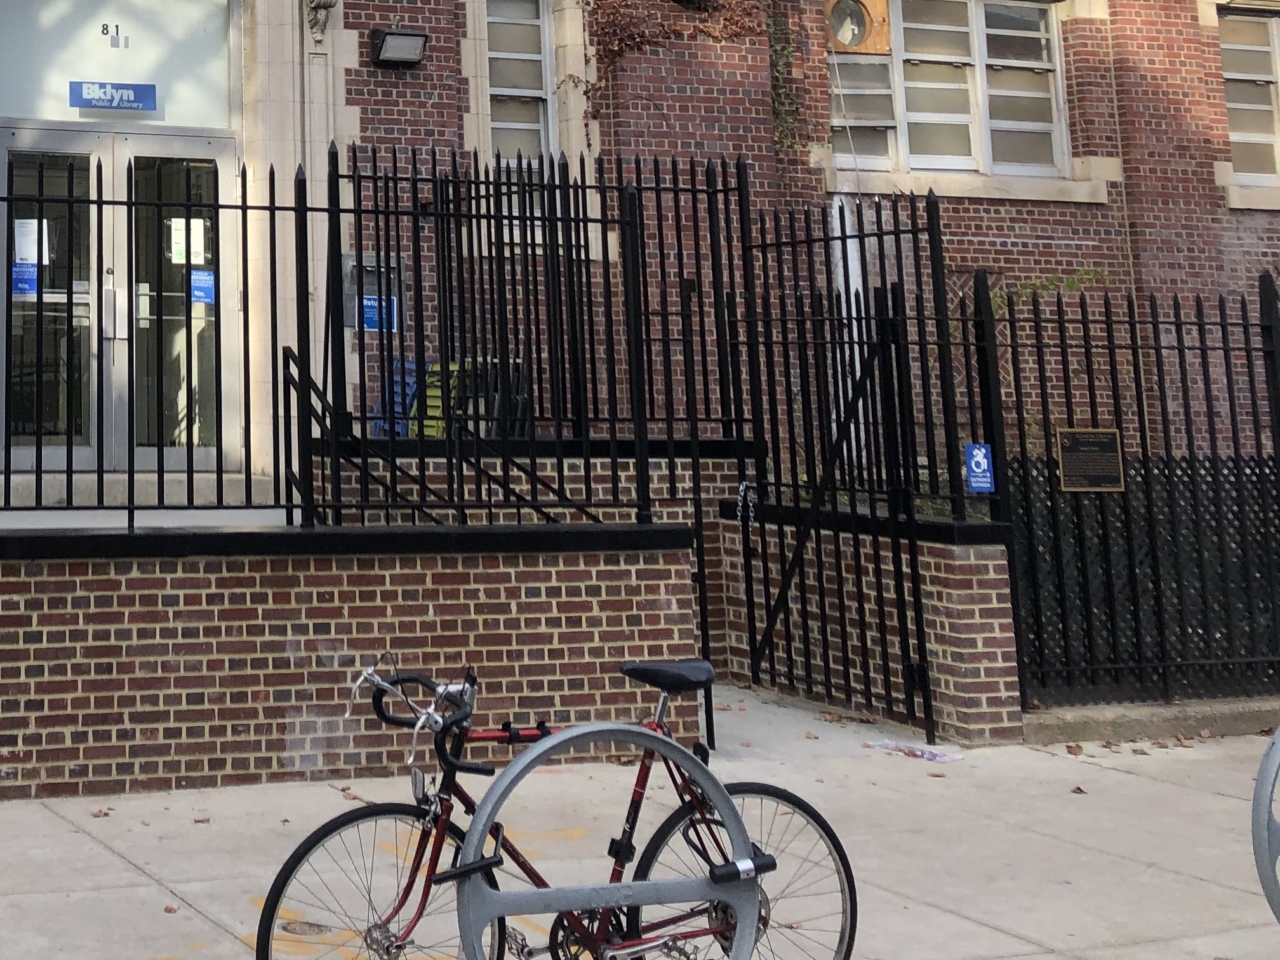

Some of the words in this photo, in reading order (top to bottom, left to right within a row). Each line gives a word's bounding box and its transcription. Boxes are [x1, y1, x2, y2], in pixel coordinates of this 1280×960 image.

[101, 23, 120, 37] 81
[82, 83, 135, 107] Bklyn
[120, 101, 143, 109] Library
